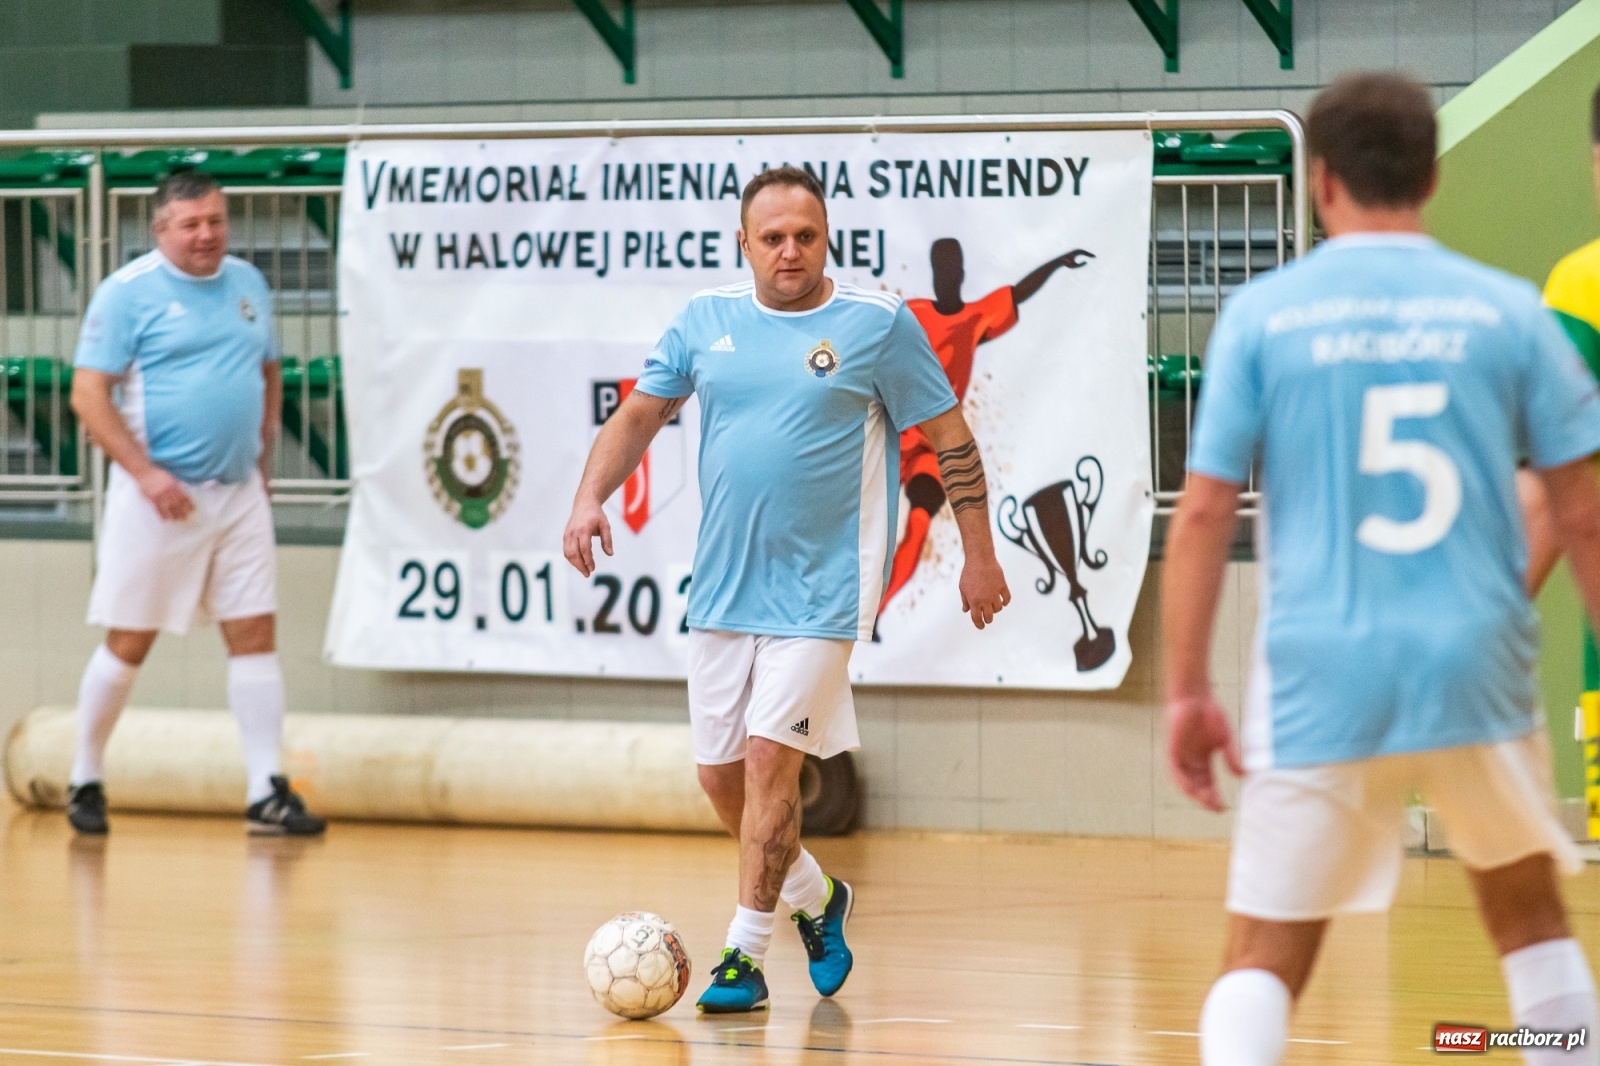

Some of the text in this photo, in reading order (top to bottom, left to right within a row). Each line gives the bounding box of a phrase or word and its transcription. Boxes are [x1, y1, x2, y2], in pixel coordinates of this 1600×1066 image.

[387, 163, 586, 203] MEMORIAŁ
[602, 161, 742, 201] IMIENIA
[761, 160, 854, 199] NA
[869, 156, 1089, 199] STANIENDY
[390, 232, 422, 269] W
[436, 230, 610, 278] HALOWEJ
[623, 230, 721, 268] PIŁCE
[1356, 381, 1462, 554] 5
